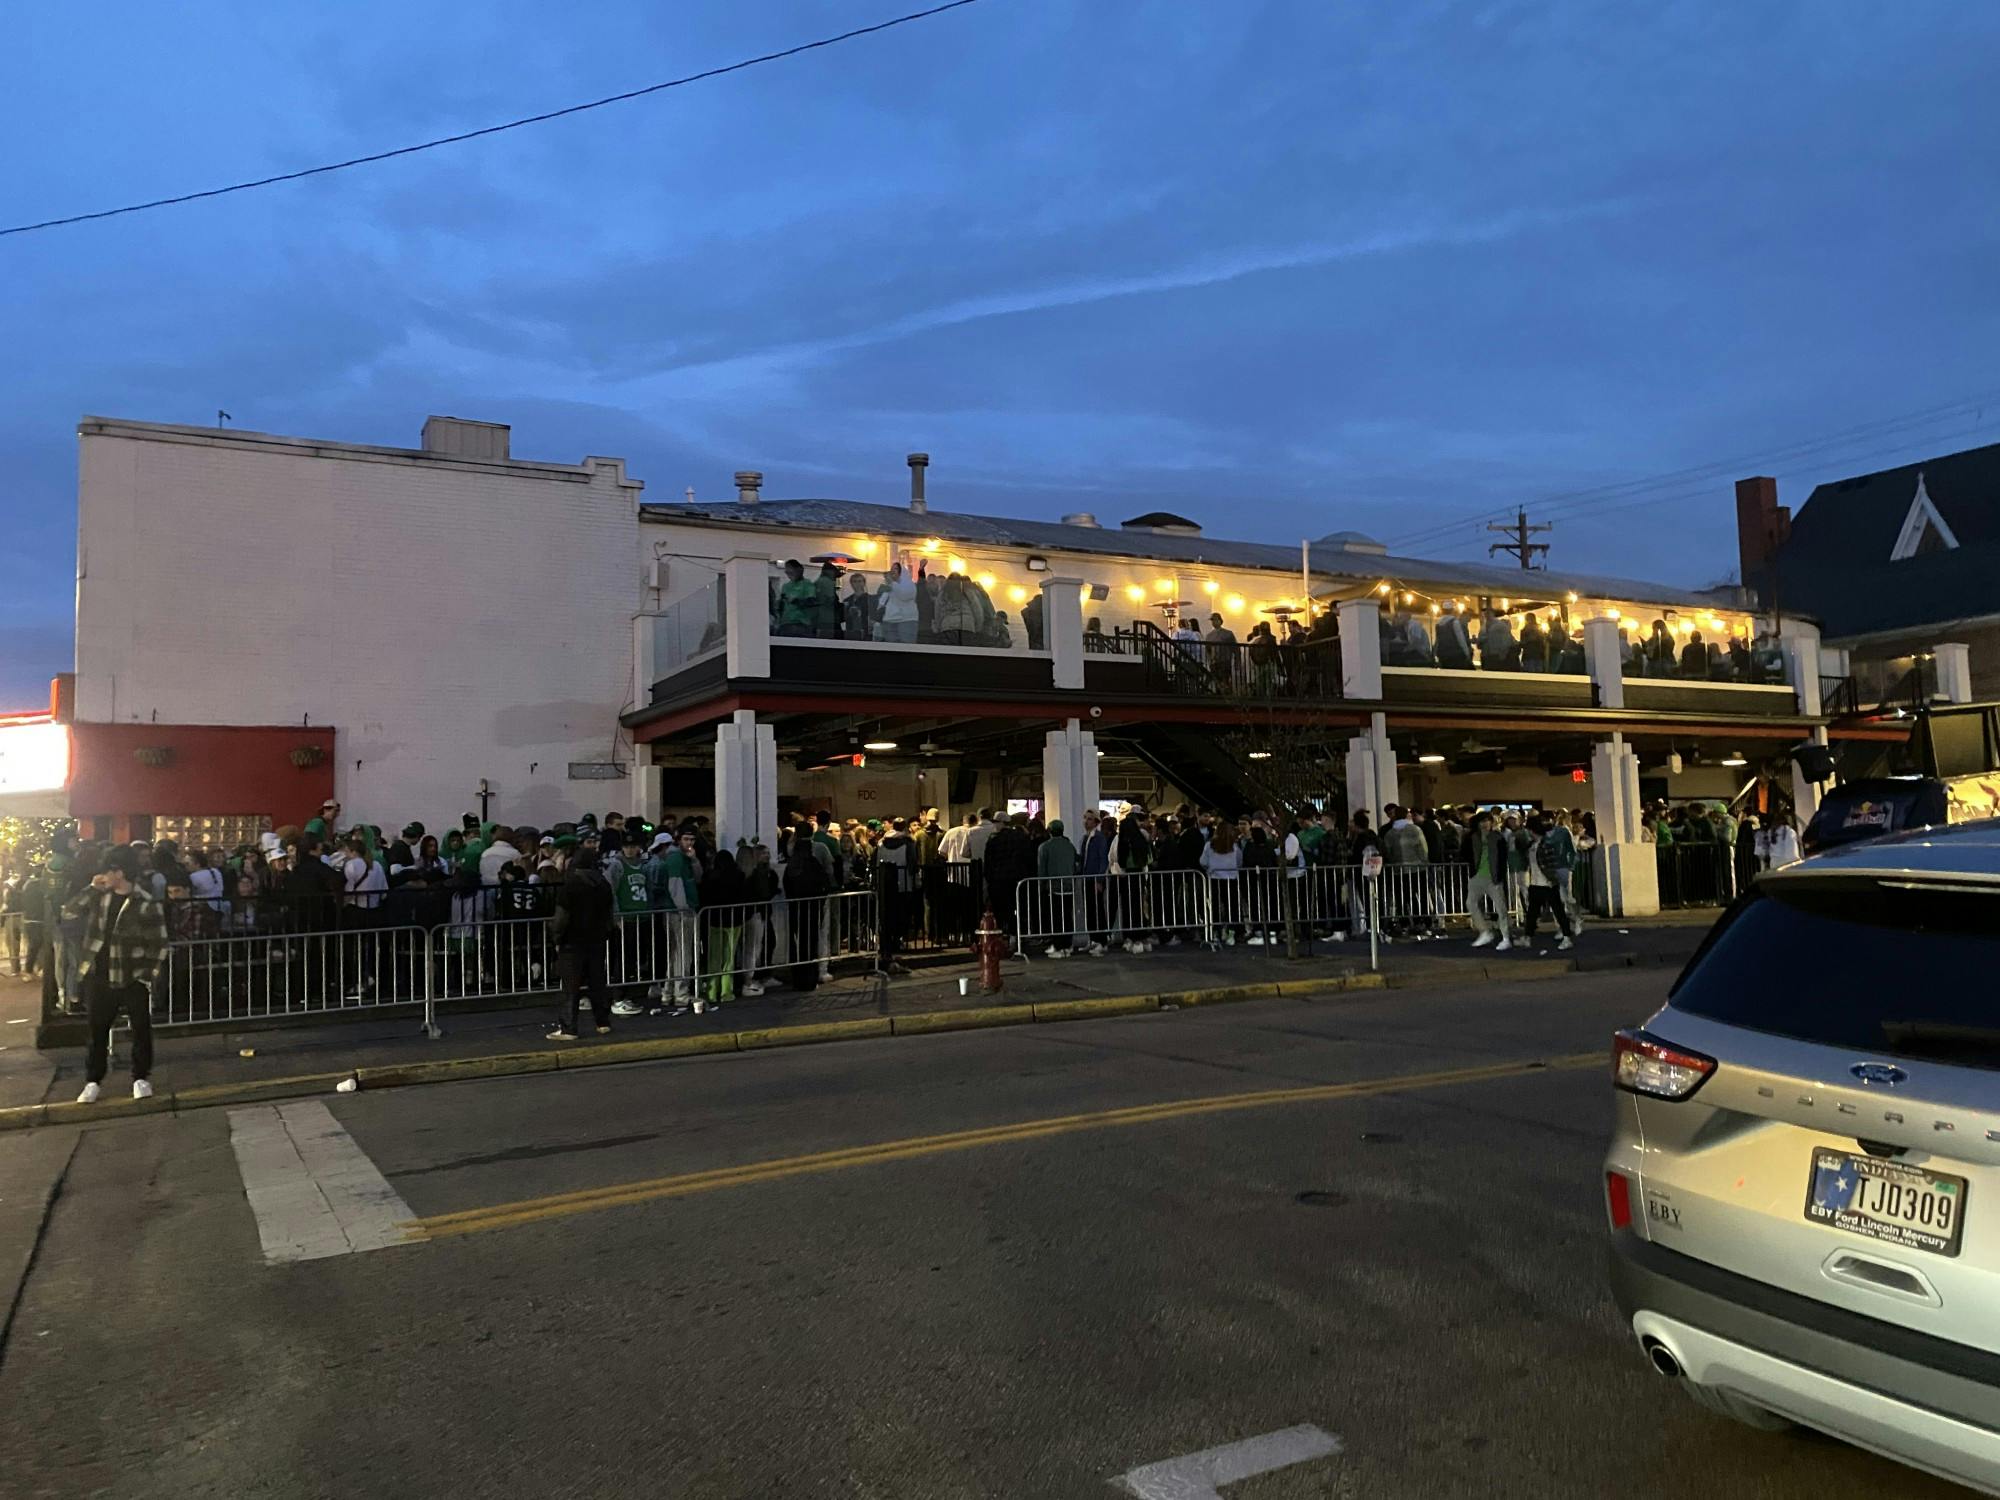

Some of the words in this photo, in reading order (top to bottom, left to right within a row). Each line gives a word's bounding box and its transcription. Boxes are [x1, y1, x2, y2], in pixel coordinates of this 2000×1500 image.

[857, 790, 877, 800] FDC
[513, 892, 534, 910] 52
[630, 885, 648, 902] 34
[1650, 1200, 1681, 1223] EBY
[1811, 1205, 1833, 1219] EBY
[1835, 1210, 1859, 1224] Ford
[1861, 1216, 1900, 1236] Lincoln
[1901, 1228, 1948, 1250] Mercury
[1879, 1231, 1919, 1248] INDIANA
